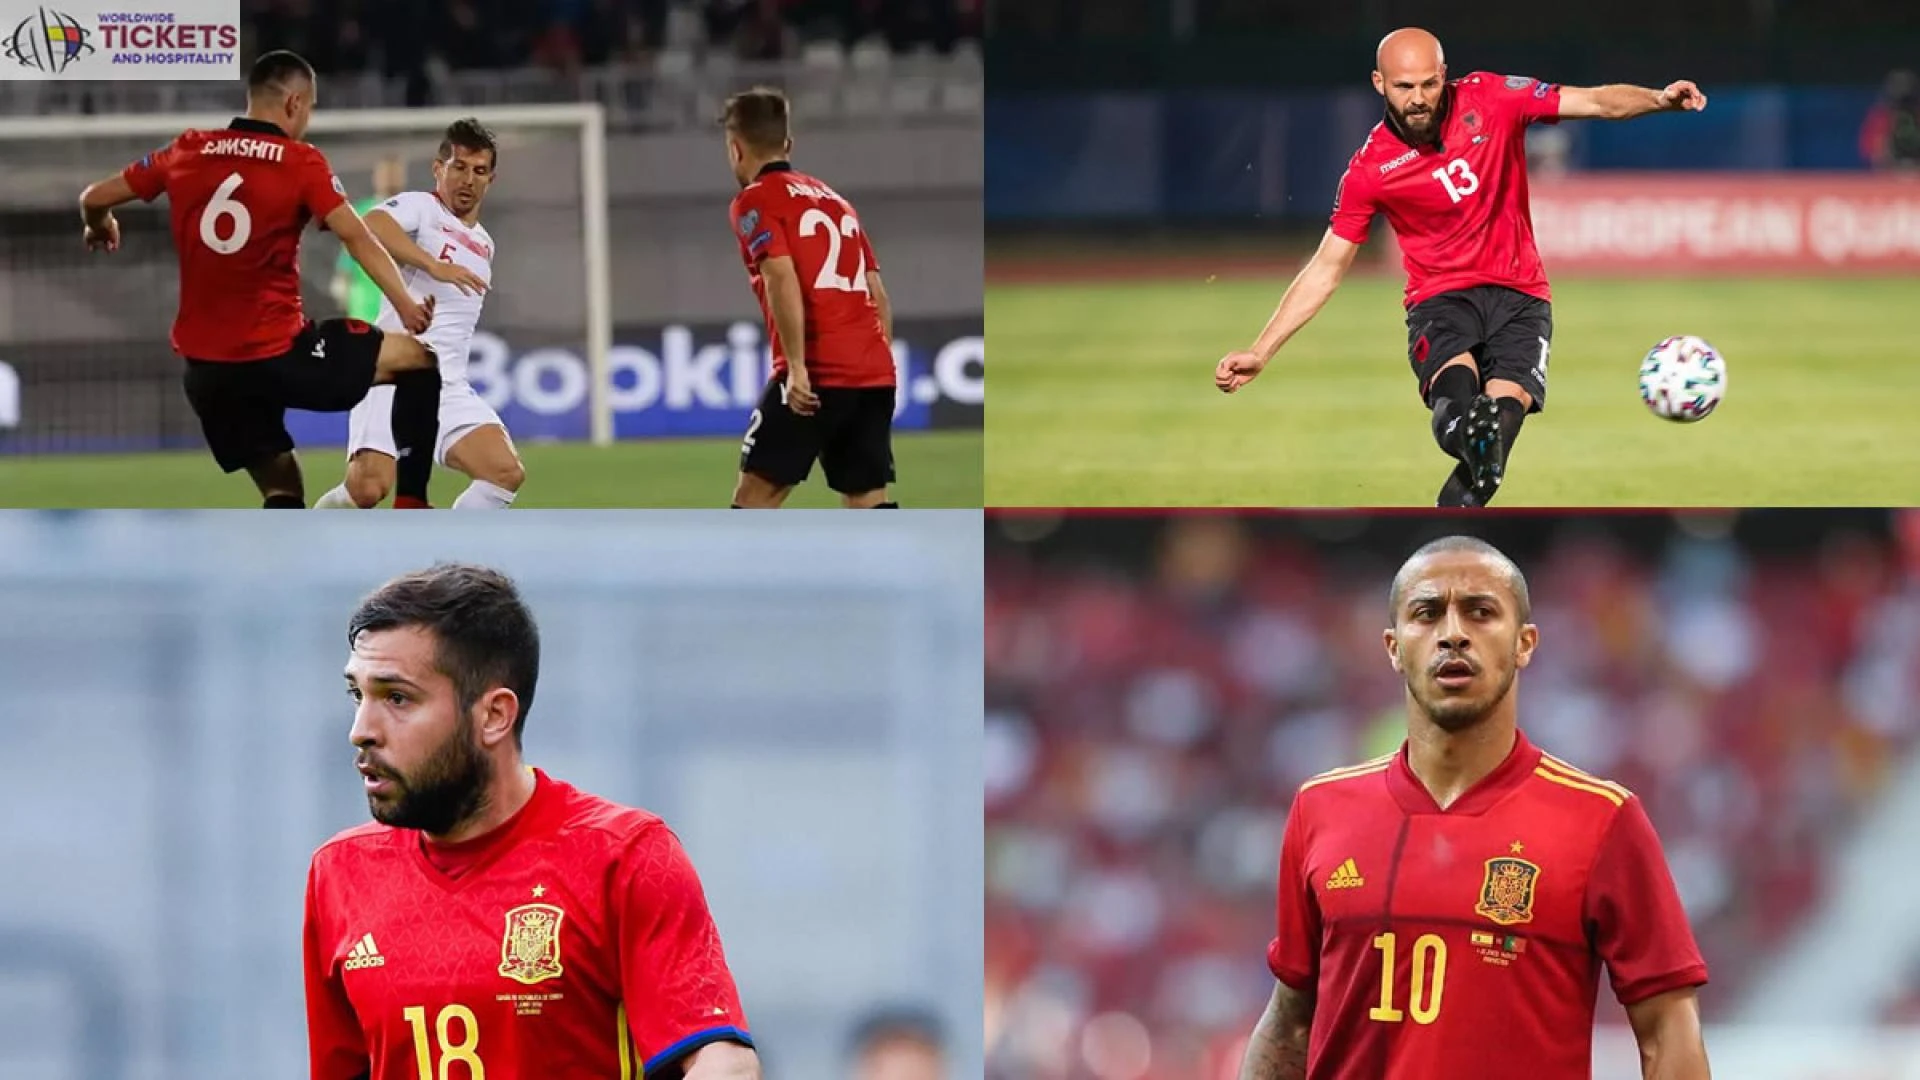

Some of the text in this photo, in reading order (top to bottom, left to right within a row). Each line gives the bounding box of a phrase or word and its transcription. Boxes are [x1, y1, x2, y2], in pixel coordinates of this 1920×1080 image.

[199, 171, 252, 255] 6
[1432, 158, 1479, 204] 13
[799, 208, 868, 292] 22
[1326, 877, 1364, 889] adidas
[345, 956, 385, 971] adidas
[1369, 932, 1447, 1024] 10
[403, 1004, 486, 1080] 18
